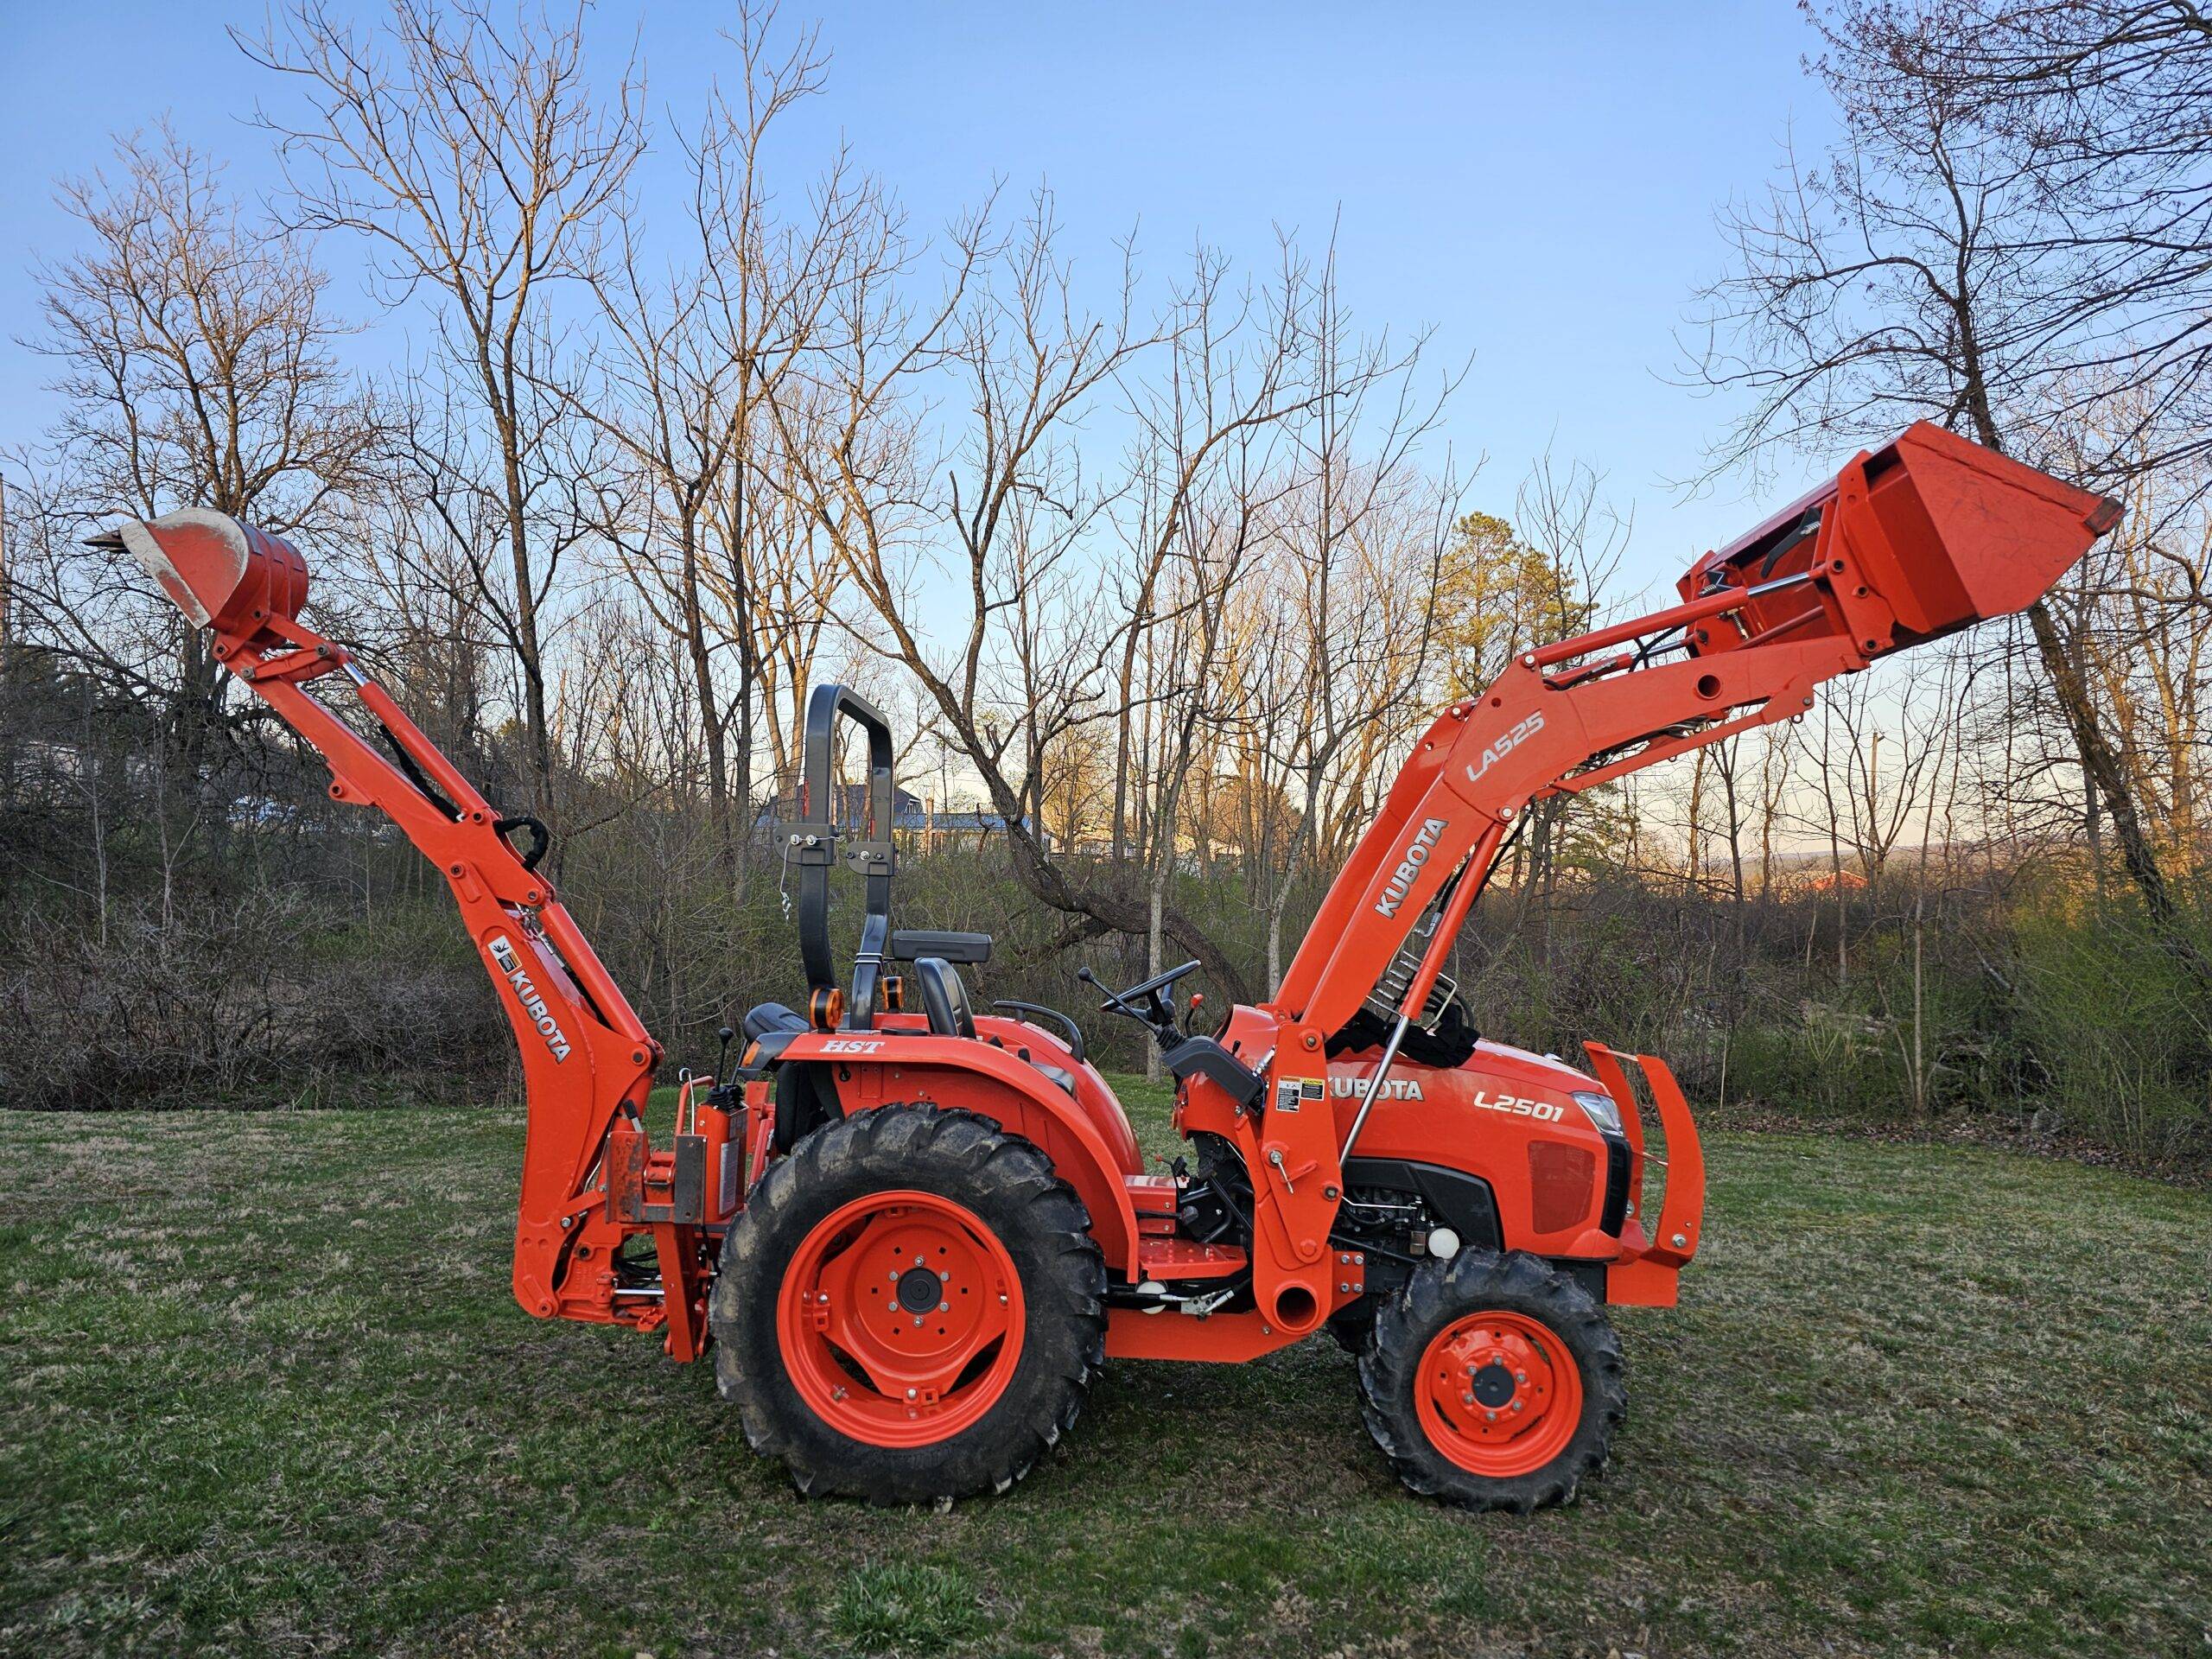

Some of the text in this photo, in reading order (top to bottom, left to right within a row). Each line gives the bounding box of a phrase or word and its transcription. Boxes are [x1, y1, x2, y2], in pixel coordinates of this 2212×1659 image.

[1466, 710, 1545, 782] LA525
[1374, 818, 1449, 919] KUBOTA
[509, 969, 571, 1064] KUBOTA
[819, 1039, 886, 1053] HST
[1473, 1091, 1564, 1122] L2501
